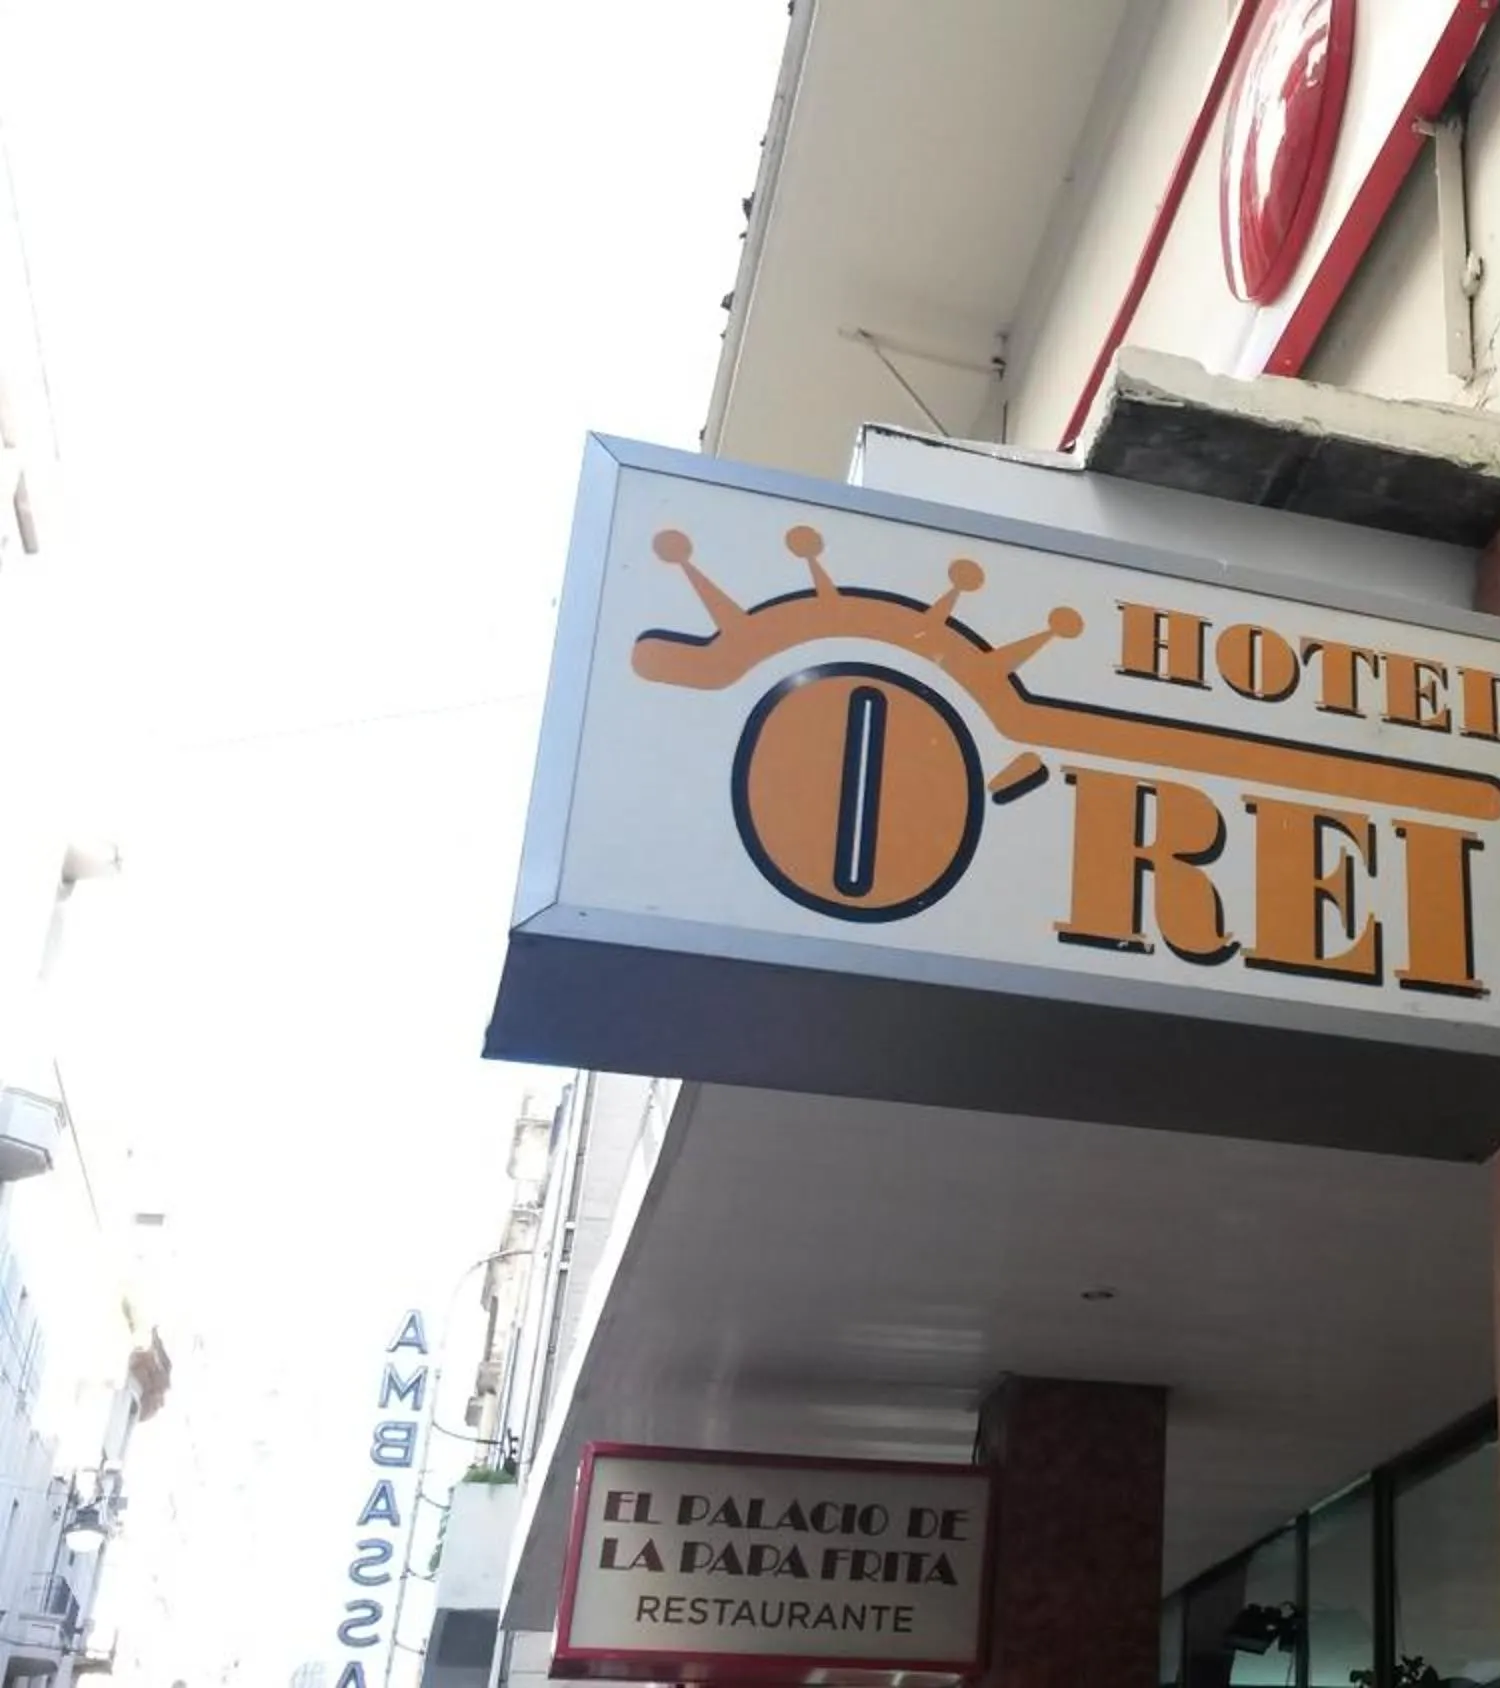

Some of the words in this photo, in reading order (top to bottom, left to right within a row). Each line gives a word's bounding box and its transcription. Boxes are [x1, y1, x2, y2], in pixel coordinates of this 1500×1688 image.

[603, 1491, 660, 1524] EL
[677, 1495, 889, 1536] PALACIO
[907, 1508, 972, 1541] DE
[599, 1538, 665, 1572] LA
[679, 1541, 808, 1579] PAPA
[820, 1548, 958, 1586] FRITA
[637, 1595, 915, 1633] RESTAURANTE
